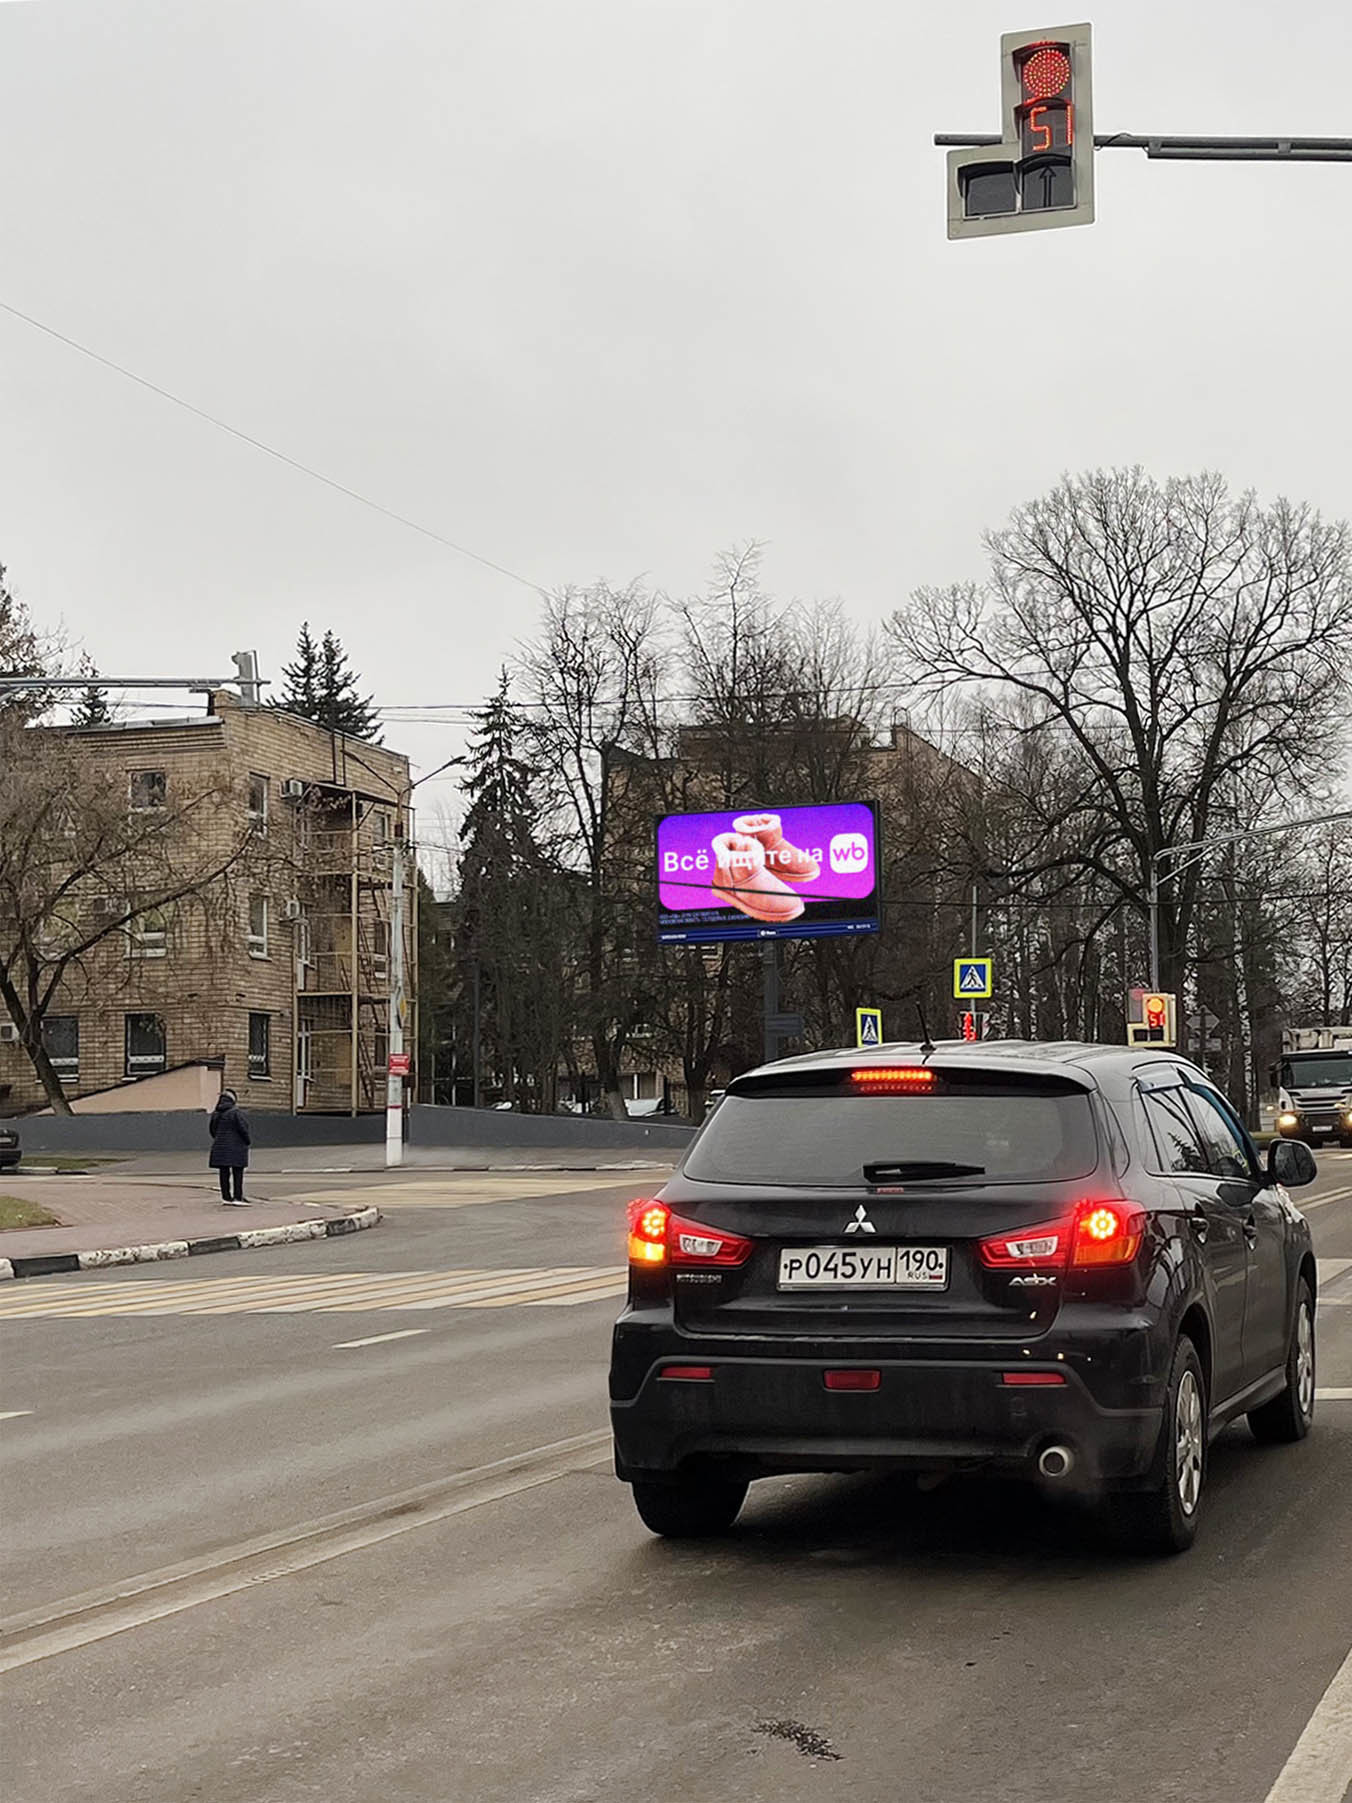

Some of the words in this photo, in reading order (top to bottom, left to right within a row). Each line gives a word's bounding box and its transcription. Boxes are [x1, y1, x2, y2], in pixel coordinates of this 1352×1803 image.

[1030, 104, 1073, 151] 51
[663, 849, 710, 873] Всё
[797, 847, 824, 864] на
[832, 841, 866, 862] wb
[900, 1249, 939, 1272] 190
[907, 1272, 928, 1280] RUS
